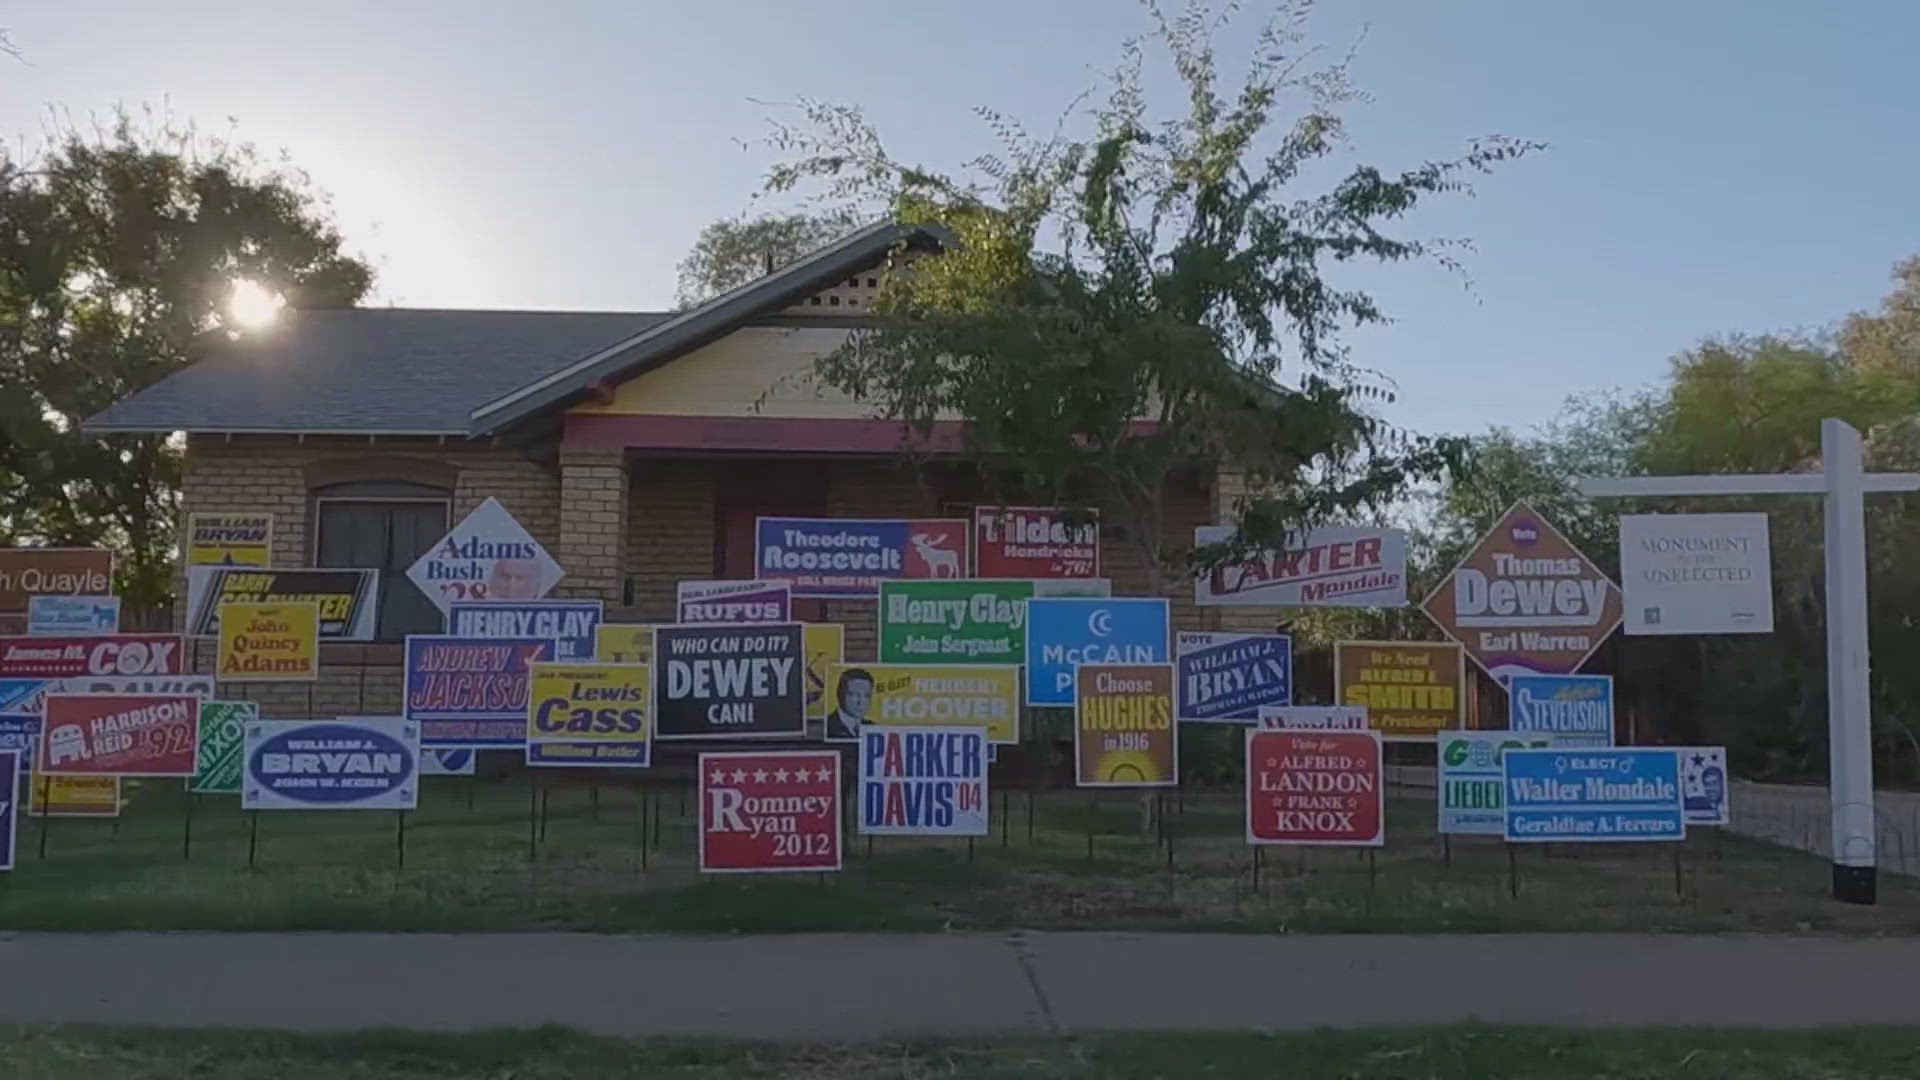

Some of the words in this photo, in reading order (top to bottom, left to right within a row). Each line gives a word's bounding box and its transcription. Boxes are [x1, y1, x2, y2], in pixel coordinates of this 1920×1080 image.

[194, 529, 267, 541] BRYAN
[784, 529, 880, 549] Theodore
[1641, 536, 1751, 553] MONUMENT
[439, 537, 535, 559] Adams
[763, 546, 901, 571] Roosevelt
[427, 560, 484, 580] Bush
[1492, 553, 1581, 575] Thomas
[1643, 567, 1752, 583] UNELECTED
[1301, 572, 1399, 601] Mondale
[1455, 568, 1608, 627] Dewey
[684, 602, 780, 620] RUFUS
[887, 594, 966, 630] Henry
[970, 594, 1025, 629] Clay
[246, 619, 289, 633] John
[457, 611, 532, 637] HENRY
[535, 611, 594, 637] CLAY
[233, 634, 300, 653] Quincy
[671, 637, 707, 654] WHO
[710, 636, 739, 652] CAN
[744, 635, 765, 652] DO
[768, 634, 789, 652] IT?
[902, 636, 938, 653] John
[1180, 635, 1212, 644] VOTE
[1262, 641, 1275, 654] J.
[1480, 632, 1517, 651] Earl
[1520, 631, 1589, 651] Warren
[89, 642, 175, 675] COX
[224, 654, 310, 672] Adams
[416, 646, 511, 671] ANDREW
[1043, 645, 1153, 665] McCAIN
[667, 658, 794, 700] DEWEY
[1096, 672, 1153, 693] Choose
[1187, 656, 1286, 707] BRYAN
[410, 673, 529, 711] JACKSO
[572, 683, 643, 700] Lewis
[90, 700, 187, 736] HARRISON
[536, 698, 643, 732] Cass
[707, 703, 754, 724] CAN!
[882, 698, 1008, 720] HOOVER
[1082, 695, 1170, 731] HUGHES
[1517, 688, 1608, 732] STEVENSON
[93, 735, 132, 757] REID
[288, 740, 360, 750] WILLIAM
[1104, 734, 1117, 751] in
[1118, 732, 1149, 752] 1916
[262, 753, 401, 775] BRYAN
[867, 732, 981, 778] PARKER
[1280, 756, 1350, 770] ALFRED
[1571, 757, 1616, 769] ELECT
[1259, 771, 1374, 793] LANDON
[1511, 776, 1583, 801] Walter
[1586, 776, 1675, 800] Mondale
[706, 787, 832, 832] Romney
[865, 782, 953, 827] DAVIS
[954, 781, 981, 811] '04
[1287, 796, 1345, 809] FRANK
[1276, 812, 1354, 833] KNOX
[1514, 816, 1594, 834] Geraldine
[772, 834, 830, 857] 2012
